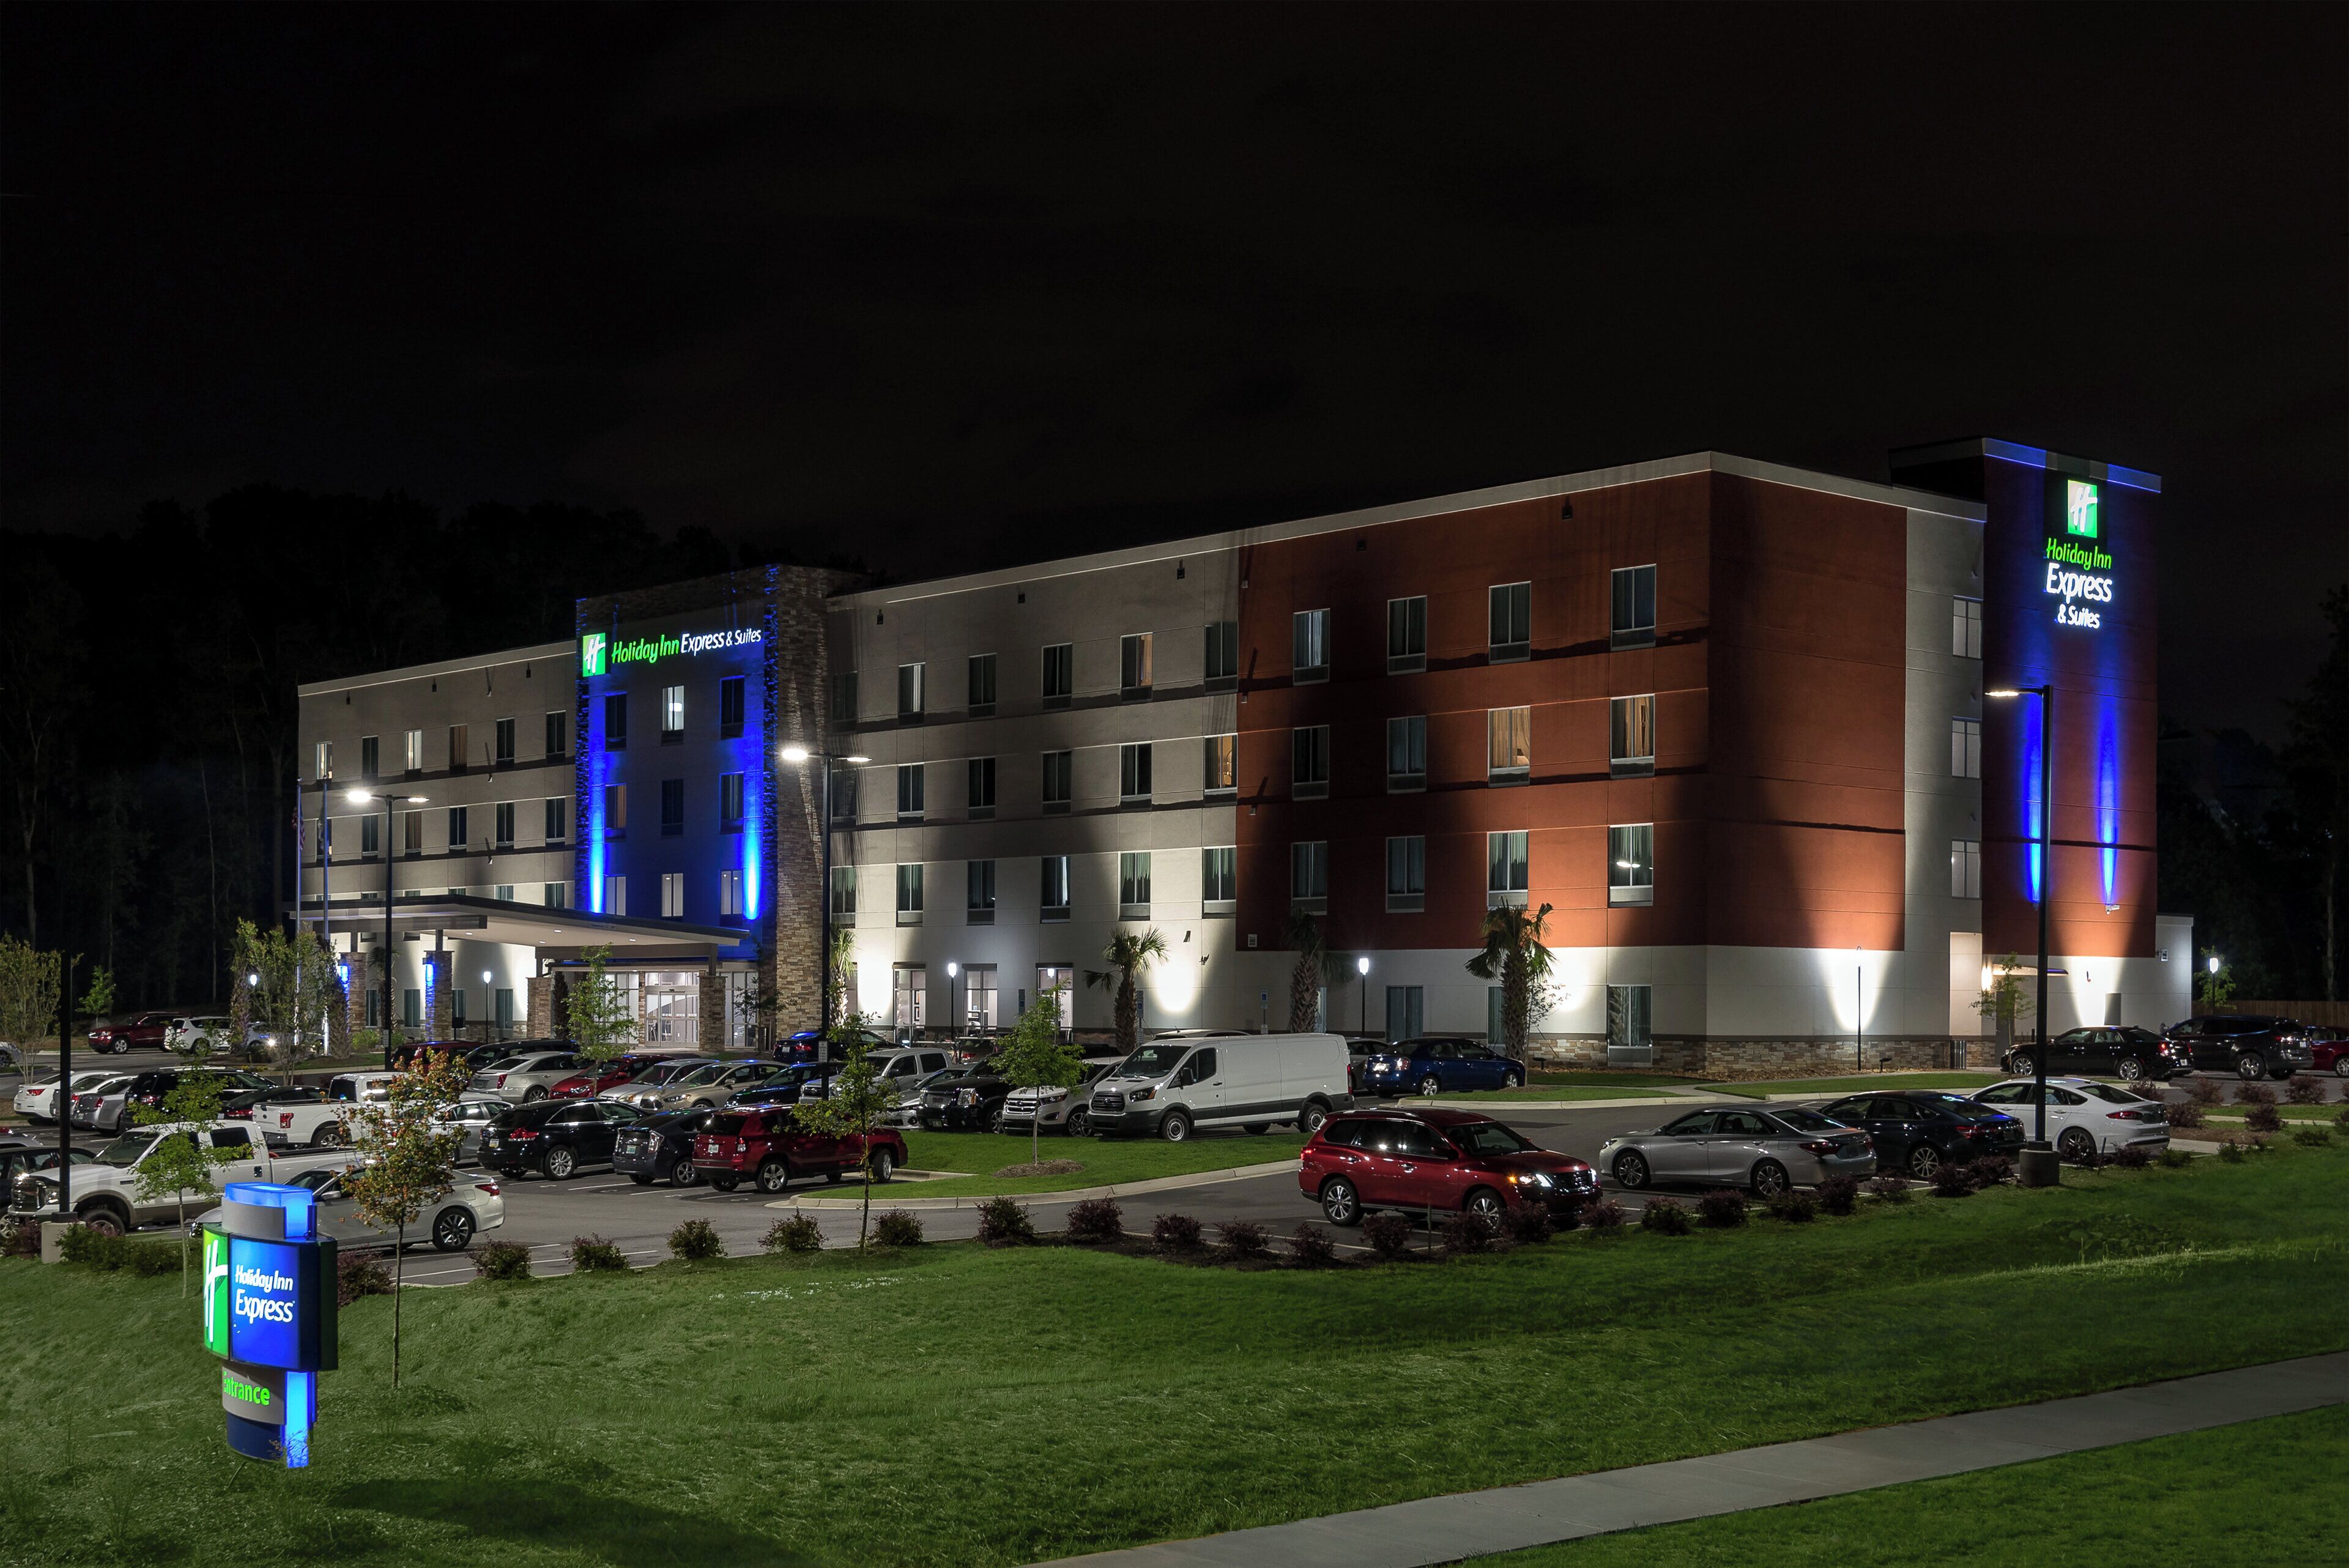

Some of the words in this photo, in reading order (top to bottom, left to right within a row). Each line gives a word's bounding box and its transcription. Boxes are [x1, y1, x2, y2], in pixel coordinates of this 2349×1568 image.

[2046, 537, 2092, 571] Holiday
[2093, 546, 2112, 570] Inn
[2046, 562, 2113, 604] Express
[2057, 603, 2066, 624] &
[2067, 605, 2100, 629] Suites
[612, 638, 659, 664] Holiday
[660, 634, 680, 656] Inn
[681, 633, 725, 656] Express
[725, 631, 733, 647] &
[734, 628, 762, 645] Suites
[235, 1264, 273, 1293] Holiday
[273, 1270, 293, 1291] Inn
[236, 1288, 294, 1324] Express
